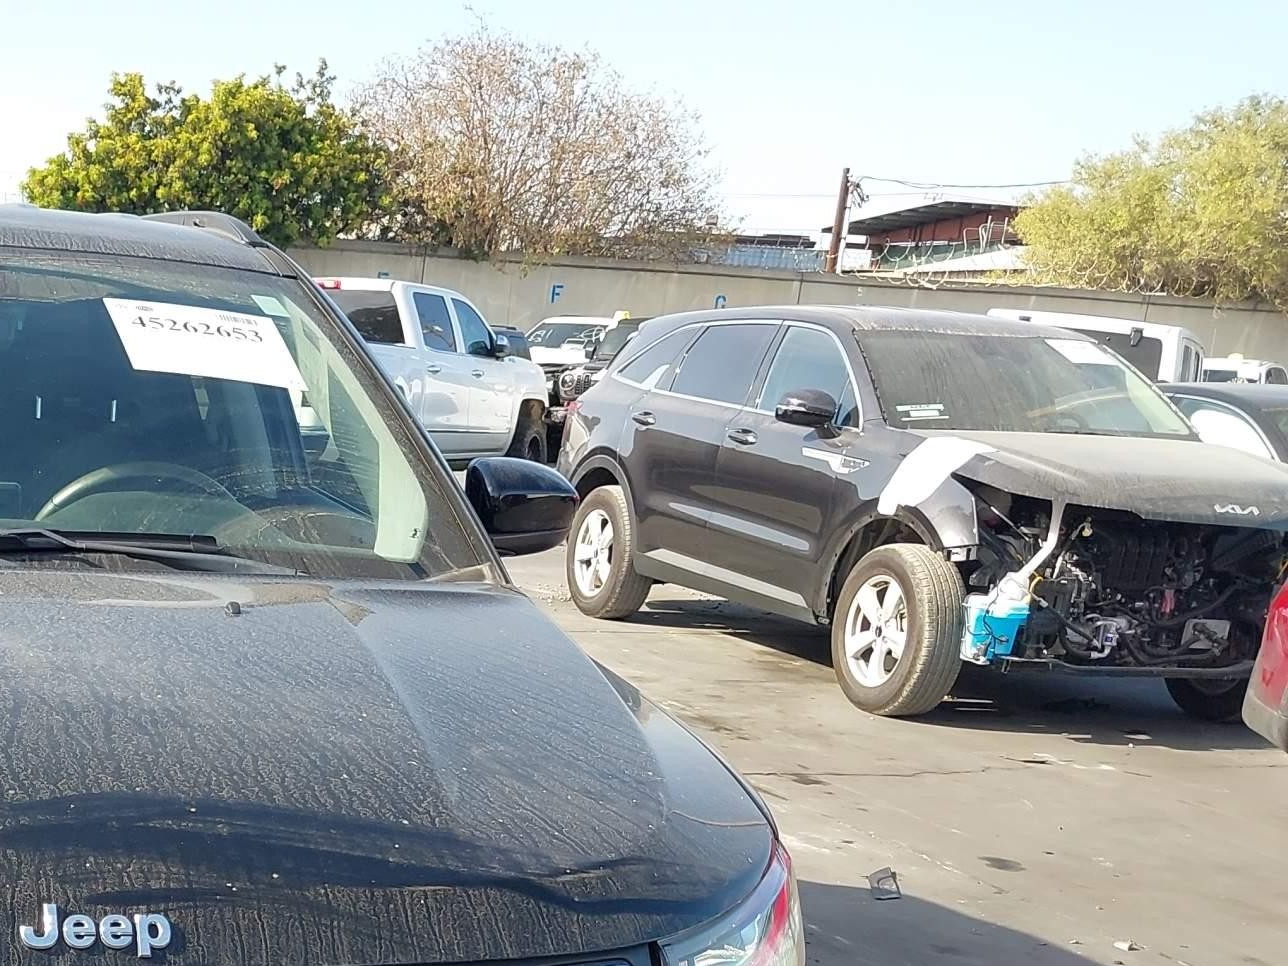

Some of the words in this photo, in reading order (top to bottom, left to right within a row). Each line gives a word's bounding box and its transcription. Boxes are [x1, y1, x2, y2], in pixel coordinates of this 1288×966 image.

[551, 284, 564, 303] F
[131, 315, 263, 342] 45262653
[19, 903, 173, 958] Jeep
